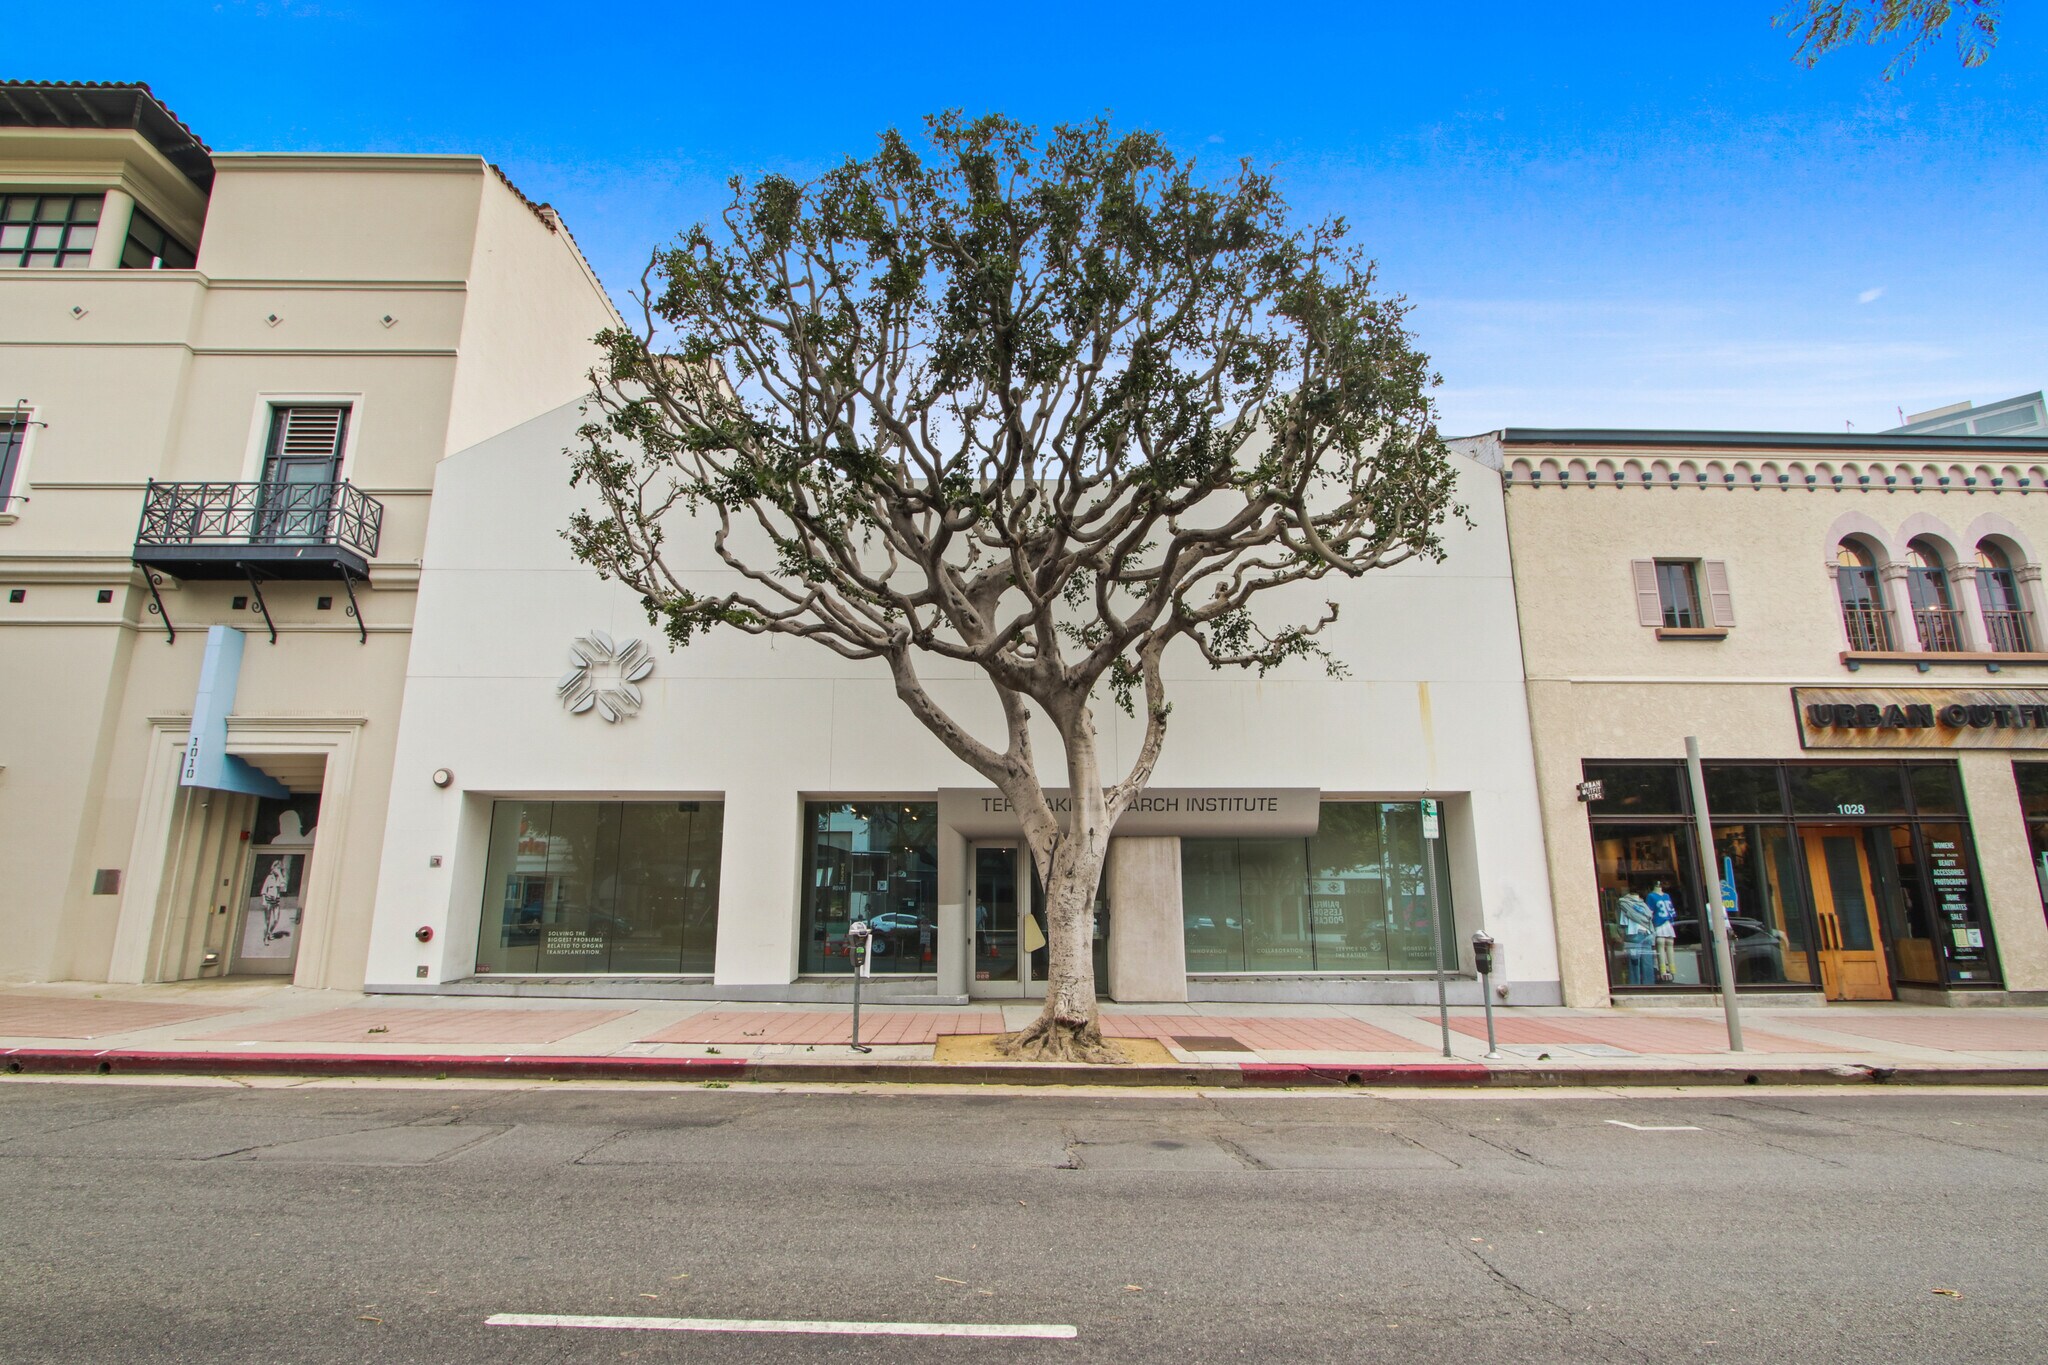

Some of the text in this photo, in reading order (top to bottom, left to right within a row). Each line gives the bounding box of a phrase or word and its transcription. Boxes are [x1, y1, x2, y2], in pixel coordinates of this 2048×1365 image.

[1806, 703, 2048, 729] URBAN OUTFI
[186, 737, 198, 778] 1010
[981, 797, 1072, 812] TERAKI
[1186, 797, 1278, 812] INSTITUTE
[1837, 804, 1866, 815] 1028
